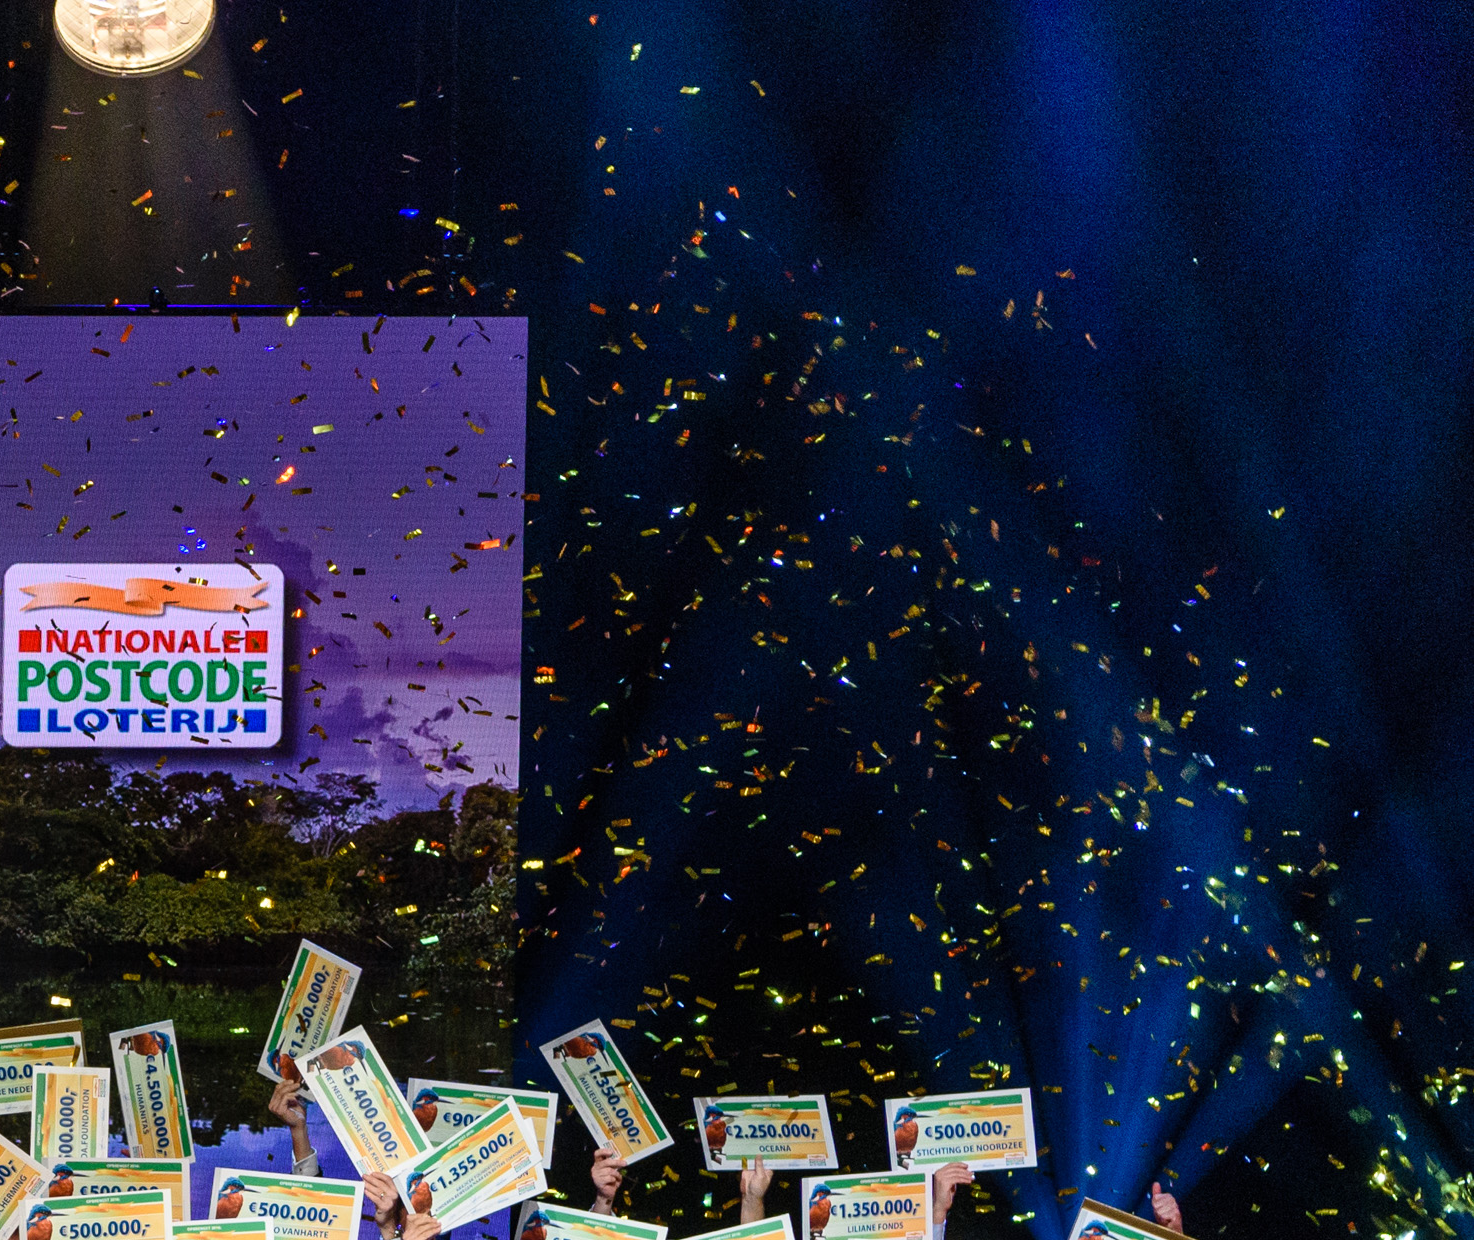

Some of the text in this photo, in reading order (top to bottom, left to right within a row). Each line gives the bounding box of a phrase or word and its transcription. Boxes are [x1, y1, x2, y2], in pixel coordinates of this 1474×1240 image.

[45, 630, 241, 653] NATIONALE
[17, 660, 268, 703] POSTCODE
[47, 708, 238, 733] LOTERIJ
[135, 1084, 150, 1135] HUMANITAS
[146, 1054, 170, 1157] €4.500.000,-
[342, 1066, 399, 1159] €5.400.000,-
[725, 1123, 819, 1142] €2.250.000,-
[924, 1120, 1012, 1141] €500.000,-
[916, 1140, 1024, 1158] STICHTING NOORDZEE
[430, 1131, 515, 1193] €1.355.000,-
[249, 1201, 339, 1226] €500.000,-
[830, 1198, 921, 1218] €1.350.000,-
[59, 1219, 151, 1240] €500.000,-
[280, 1226, 330, 1240] VANHARTE
